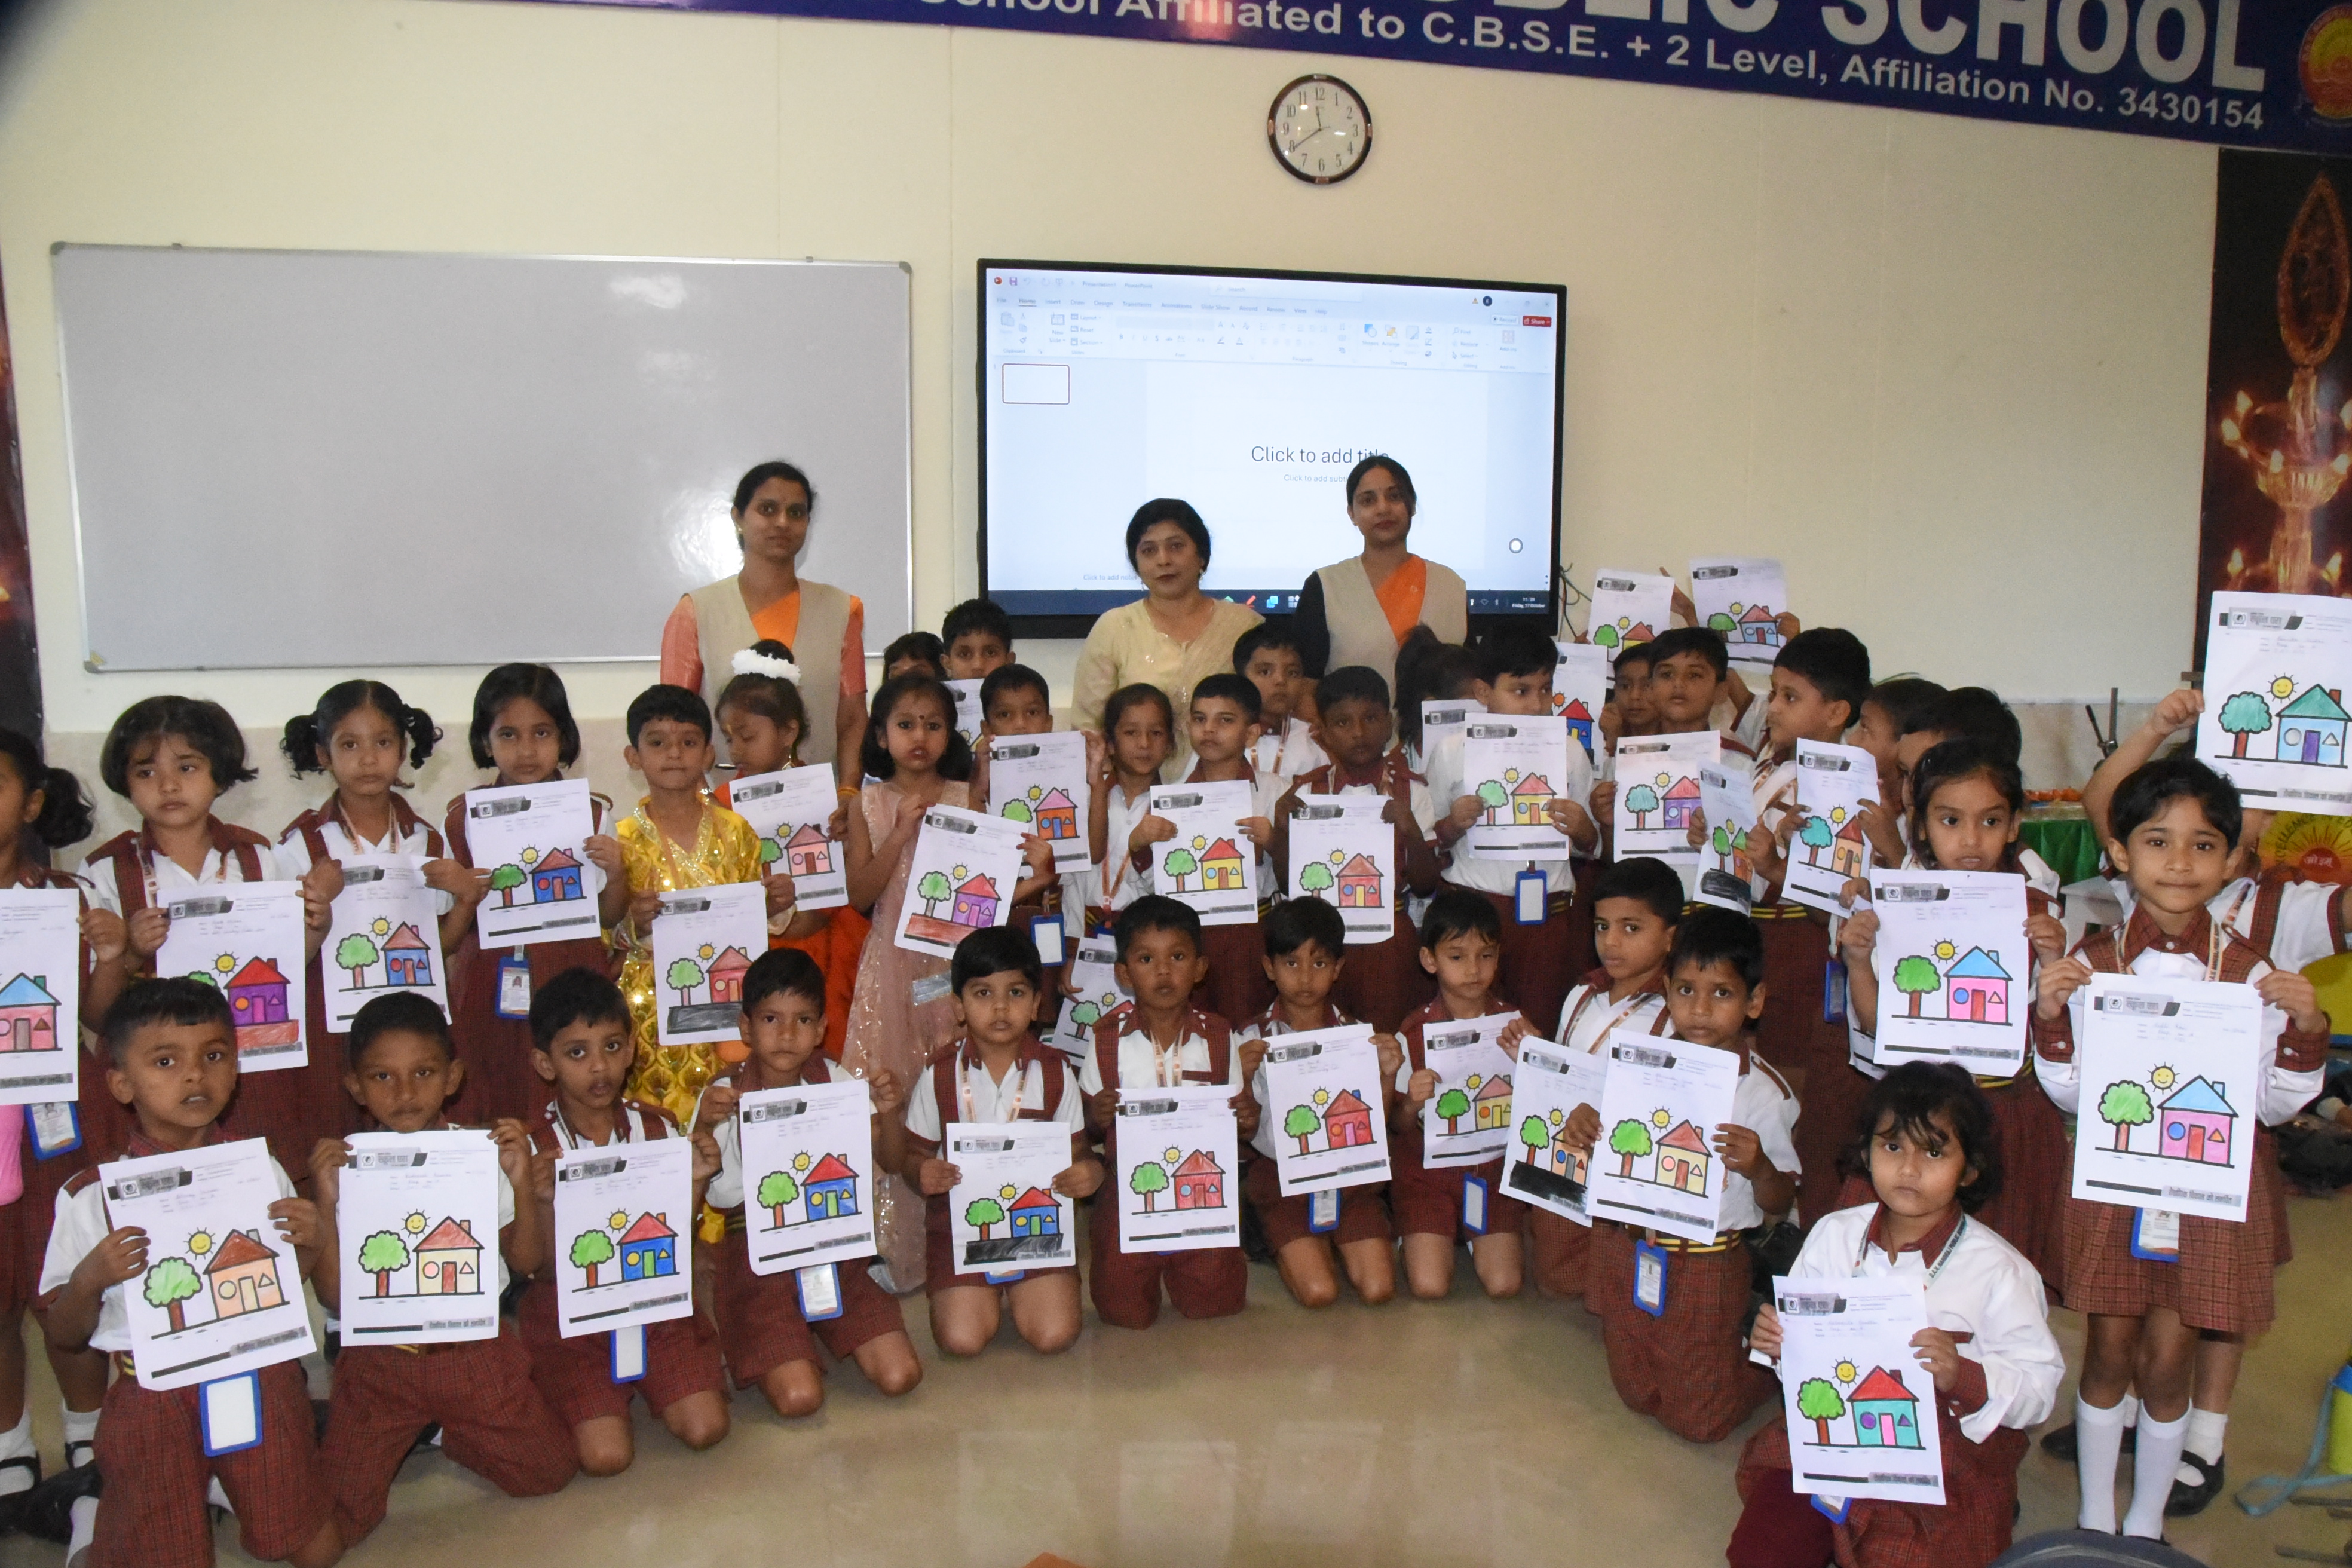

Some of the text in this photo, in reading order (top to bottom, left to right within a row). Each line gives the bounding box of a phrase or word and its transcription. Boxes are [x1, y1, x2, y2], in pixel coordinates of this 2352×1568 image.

[1115, 0, 1341, 34] Affiliated
[1359, 7, 1405, 39] to
[1423, 12, 1609, 58] C.B.S.E.
[1666, 35, 1689, 65] 2
[1707, 39, 1827, 85] Level,
[1840, 54, 2029, 103] Affiliation
[2045, 78, 2103, 112] No.
[2118, 87, 2264, 129] 3430154
[1298, 91, 1307, 105] 11
[1316, 88, 1325, 100] 12
[1335, 92, 1339, 106] 1
[1287, 105, 1296, 117] 10
[1347, 106, 1353, 119] 2
[1283, 122, 1289, 135] 9
[1353, 124, 1358, 137] 3
[1289, 140, 1296, 153] 8
[1348, 142, 1353, 155] 4
[1301, 153, 1307, 167] 7
[1318, 158, 1325, 172] 6
[1336, 154, 1342, 167] 5
[1251, 446, 1295, 463] Click
[1300, 449, 1316, 463] to
[1321, 448, 1352, 463] add
